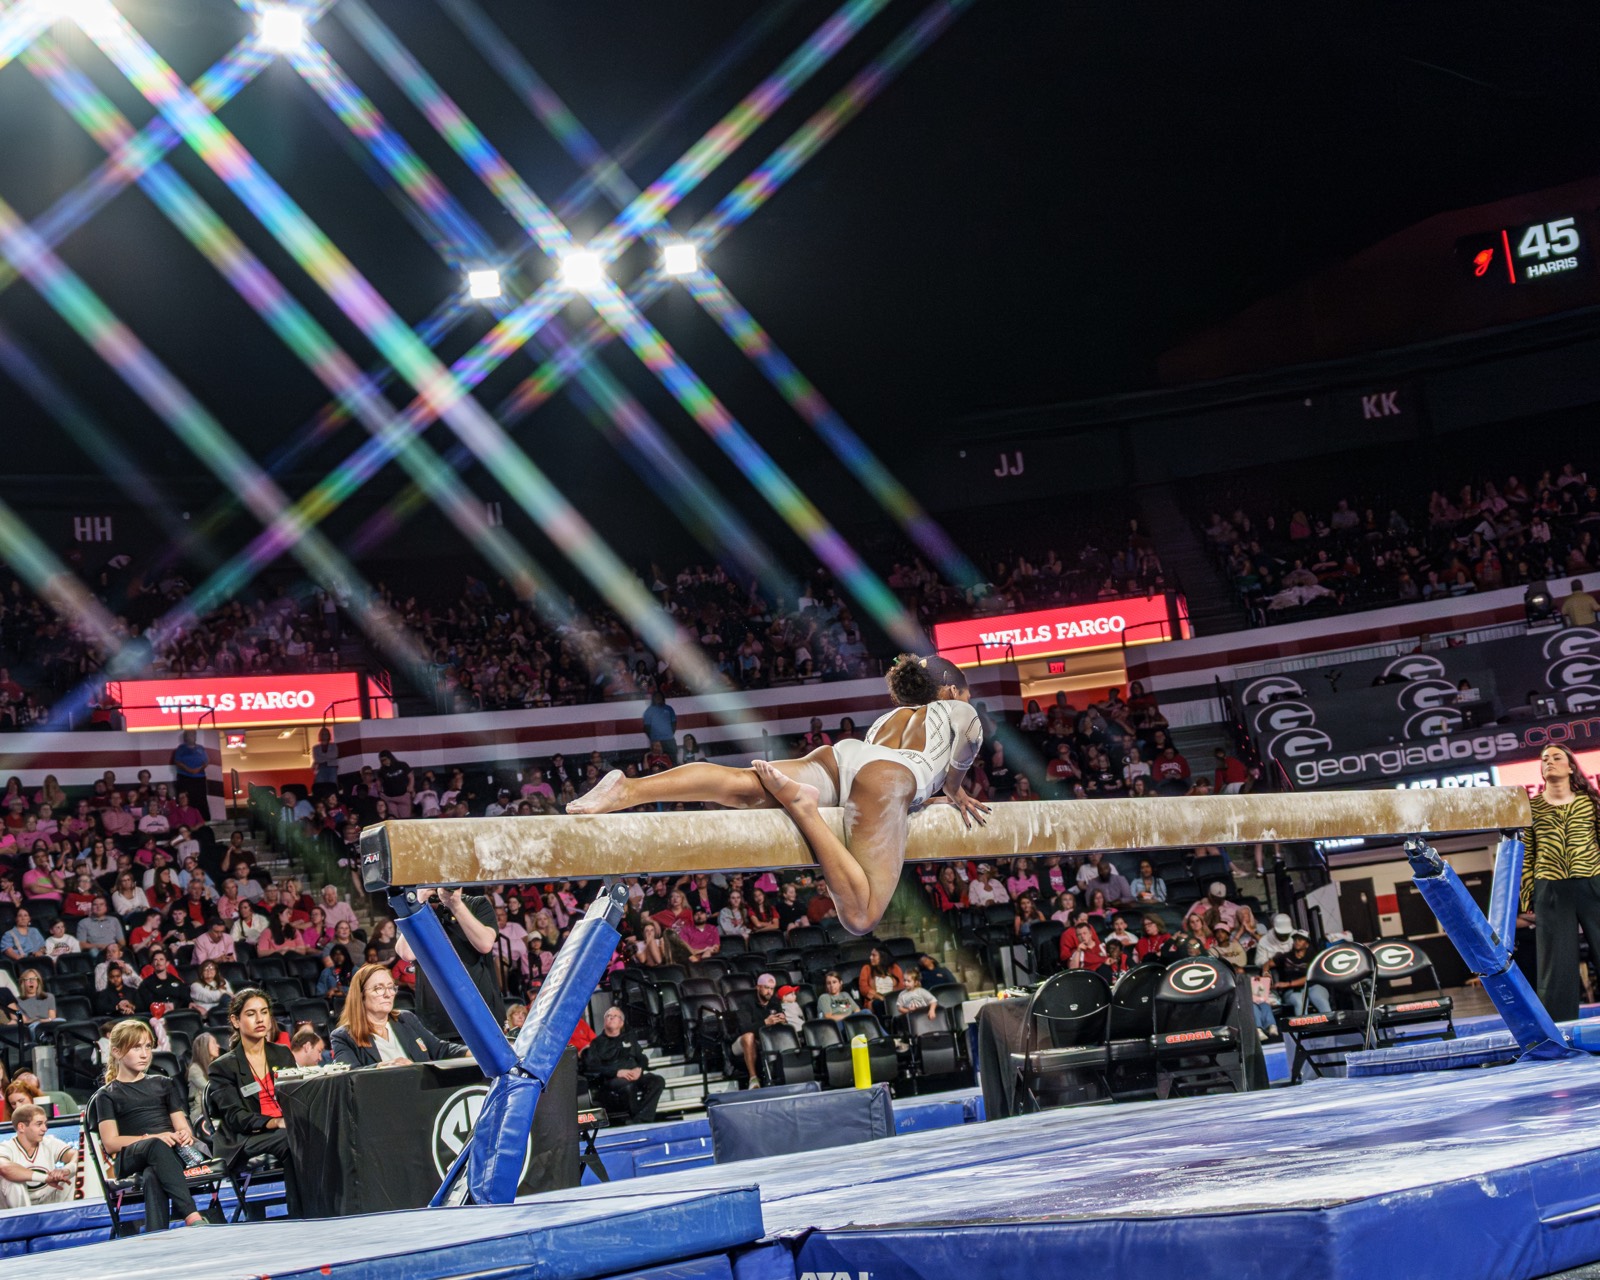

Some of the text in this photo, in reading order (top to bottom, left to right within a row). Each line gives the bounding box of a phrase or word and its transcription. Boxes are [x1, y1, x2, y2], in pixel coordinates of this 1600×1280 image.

[1517, 216, 1580, 259] 45
[1527, 256, 1579, 279] HARRIS
[1362, 390, 1401, 420] KK
[994, 451, 1024, 477] JJ
[73, 516, 112, 541] HH
[979, 615, 1126, 650] WELLS FARGO
[156, 690, 315, 714] WELLS FARGO
[1396, 999, 1440, 1012] GEORGIA
[1288, 1014, 1328, 1026] GEORGIA
[1165, 1030, 1215, 1043] GEORGIA
